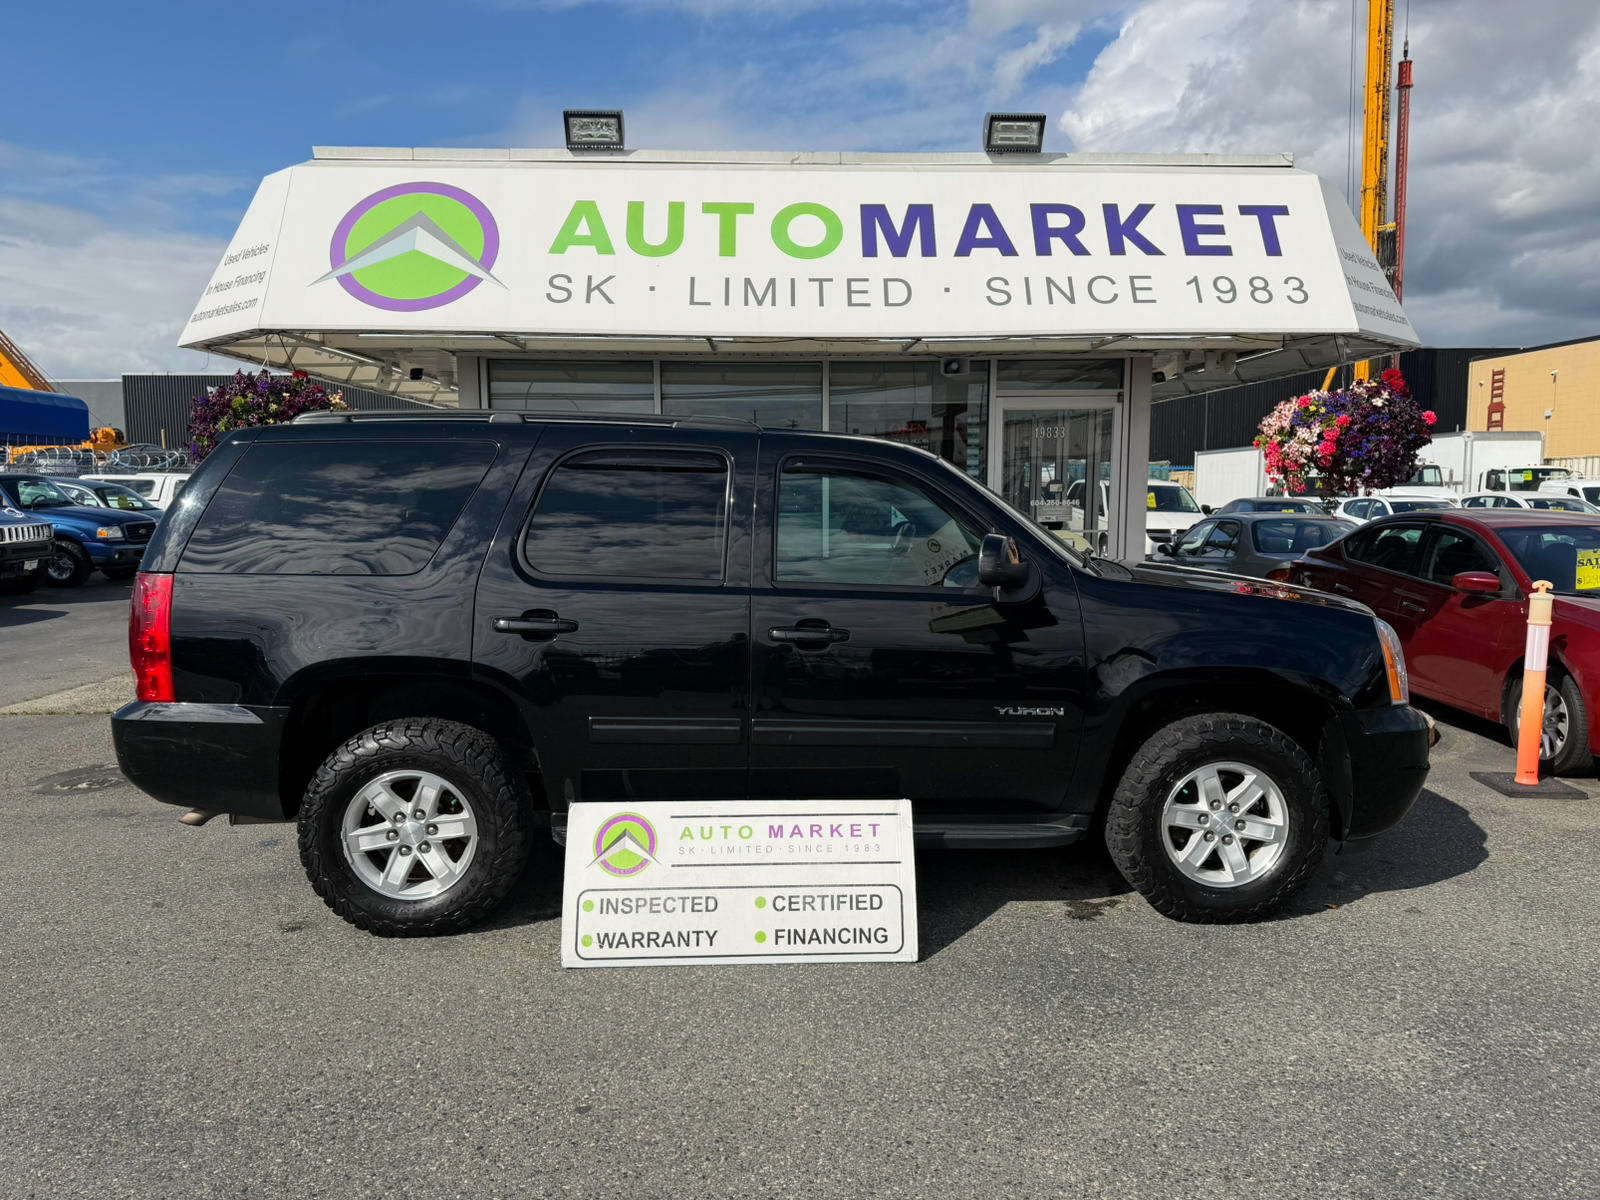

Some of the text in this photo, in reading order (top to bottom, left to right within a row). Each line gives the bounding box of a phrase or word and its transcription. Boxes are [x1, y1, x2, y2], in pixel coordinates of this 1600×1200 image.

[549, 201, 1289, 259] AUTOMARKET
[224, 243, 270, 266] Used Vehicles
[1339, 247, 1379, 272] Used Vehicles
[205, 270, 267, 296] In House Financing
[546, 274, 1308, 306] SK LIMITED SINCE 1983
[1345, 274, 1398, 304] In House Financing
[190, 298, 259, 323] automarketsales.com
[1353, 301, 1410, 326] automarketsales.com
[890, 423, 928, 437] OPEN
[1034, 426, 1066, 439] 19833
[993, 706, 1065, 717] YUKON
[679, 823, 881, 840] AUTO MARKET
[678, 843, 882, 855] SK LIMITED SINCE 1983
[599, 894, 884, 915] INSPECTED CERTIFIED
[597, 927, 889, 949] WARRANTY FINANCING
